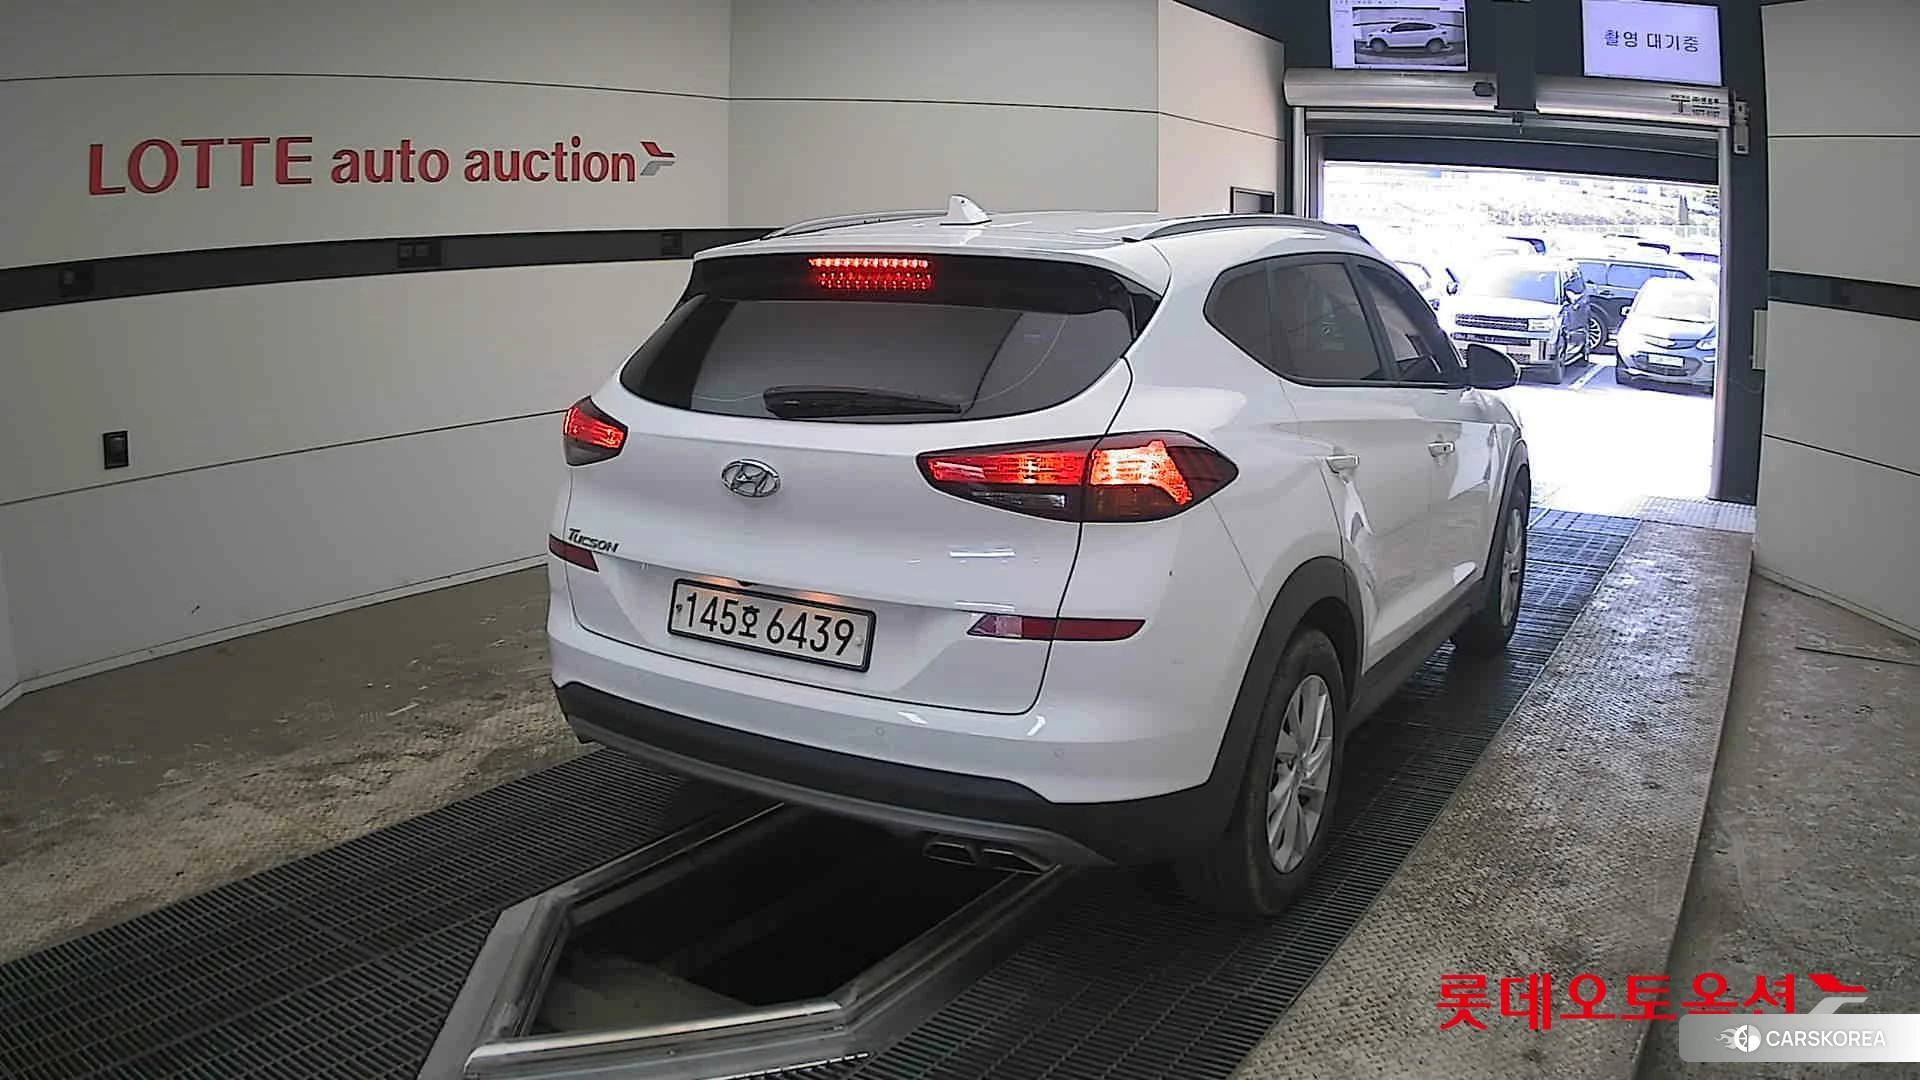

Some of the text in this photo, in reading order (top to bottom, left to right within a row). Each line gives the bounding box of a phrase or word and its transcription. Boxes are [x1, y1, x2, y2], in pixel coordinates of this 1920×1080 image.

[1605, 30, 1699, 53] 촬영 대기중
[88, 135, 637, 195] LOTTE auto auction
[686, 591, 855, 656] 145호 6439
